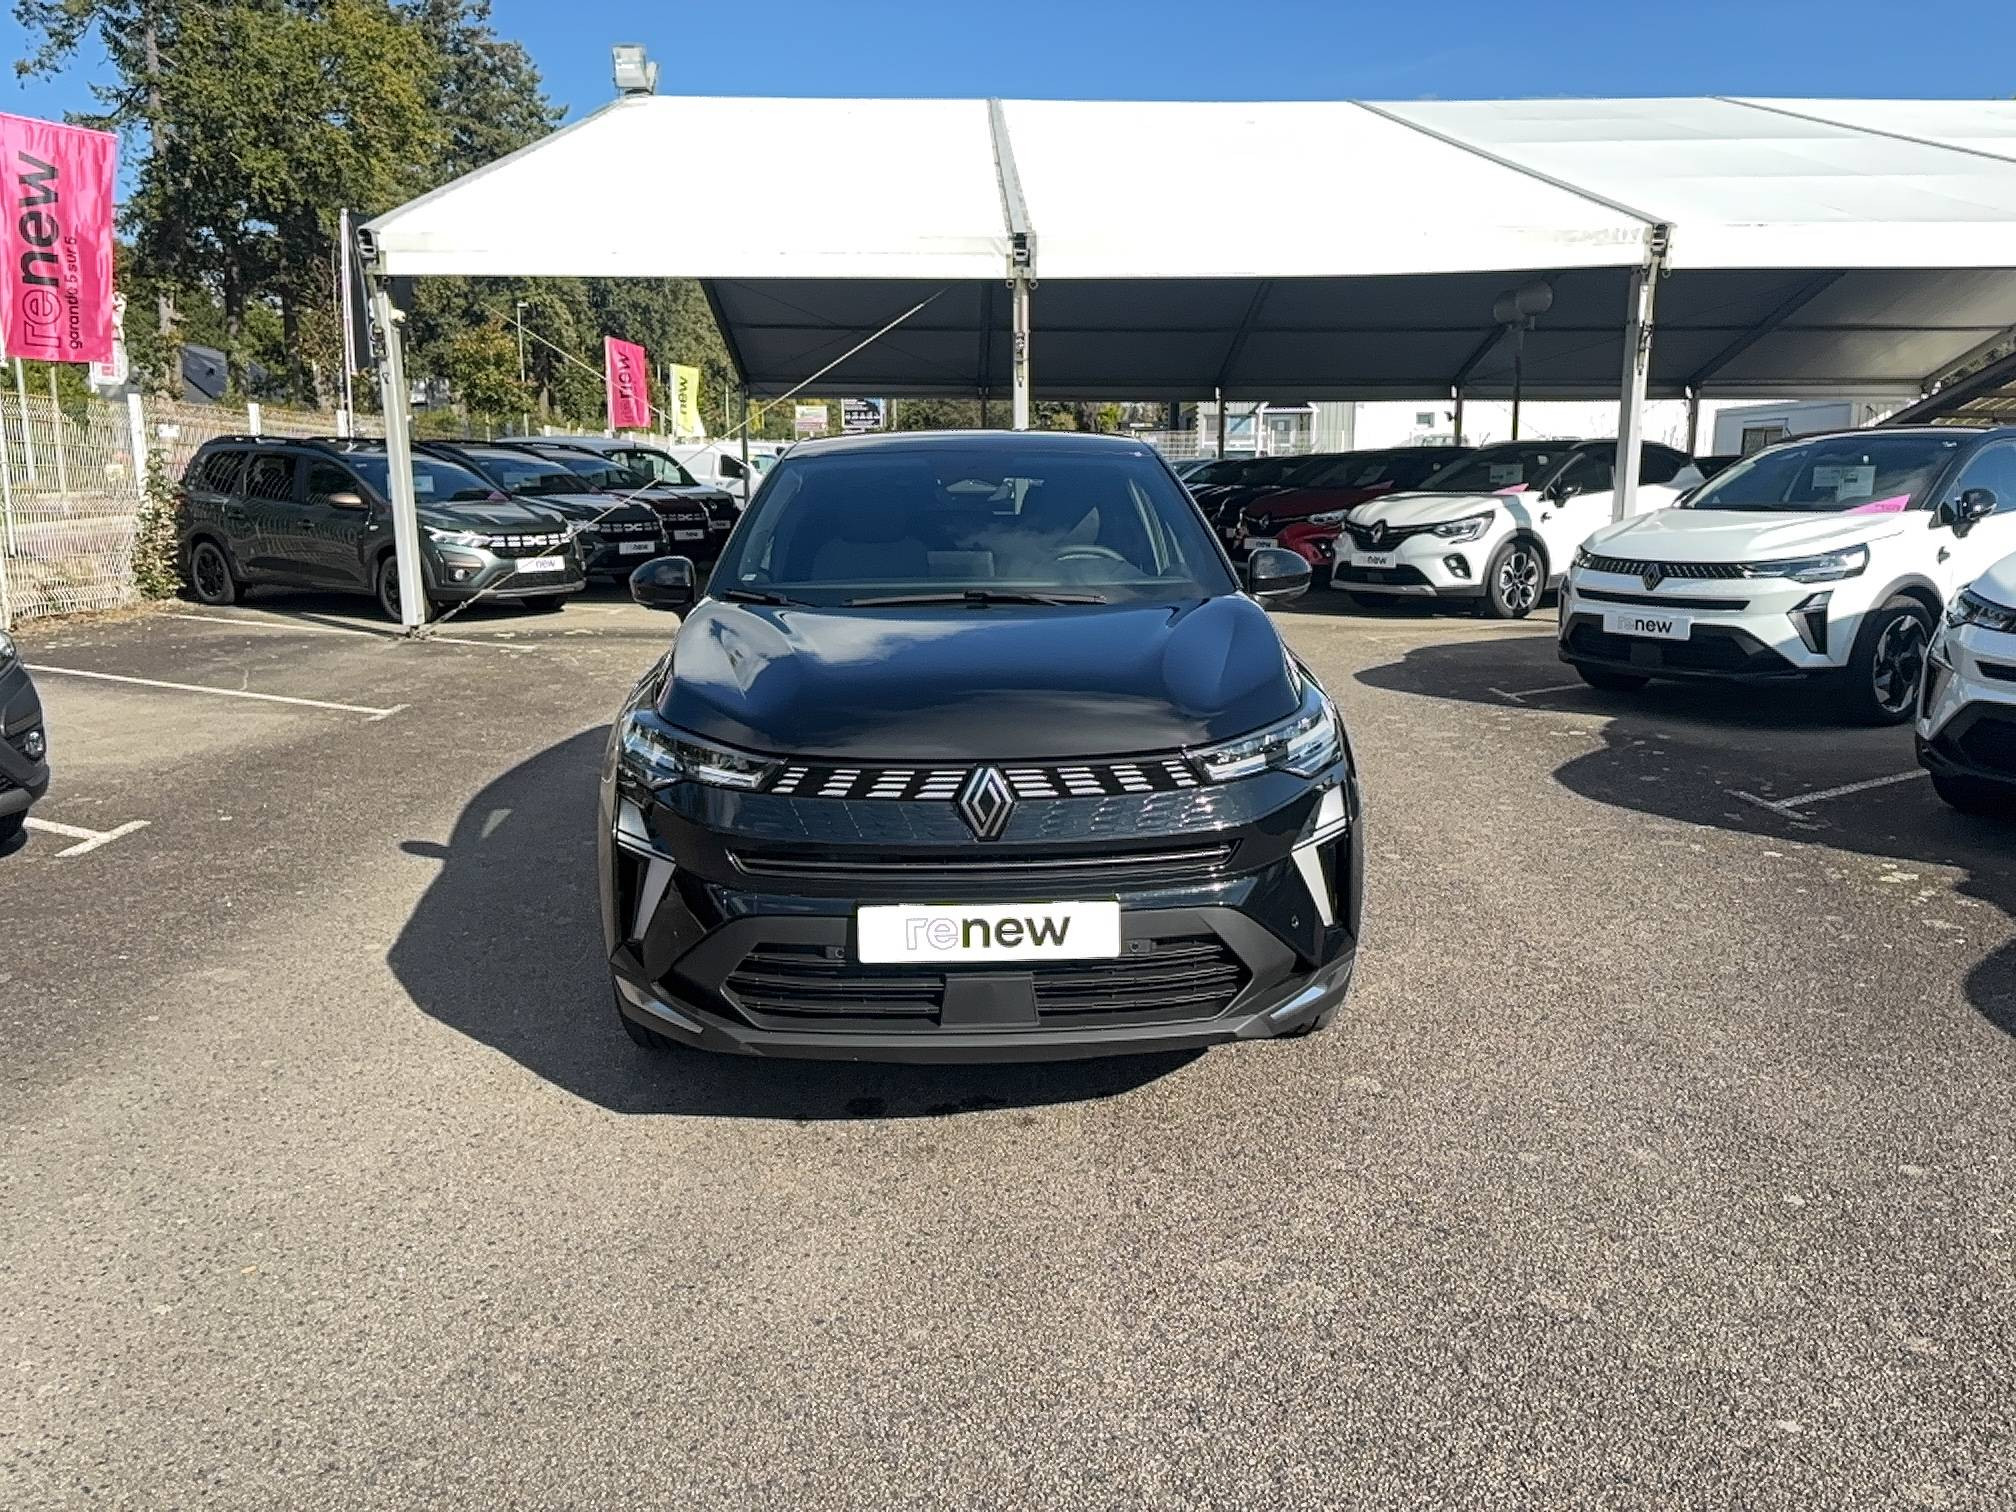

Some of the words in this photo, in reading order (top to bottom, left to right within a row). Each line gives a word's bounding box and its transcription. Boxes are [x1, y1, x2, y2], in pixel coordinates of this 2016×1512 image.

[18, 150, 63, 349] renew
[66, 248, 78, 272] sur
[905, 916, 1072, 951] renew
